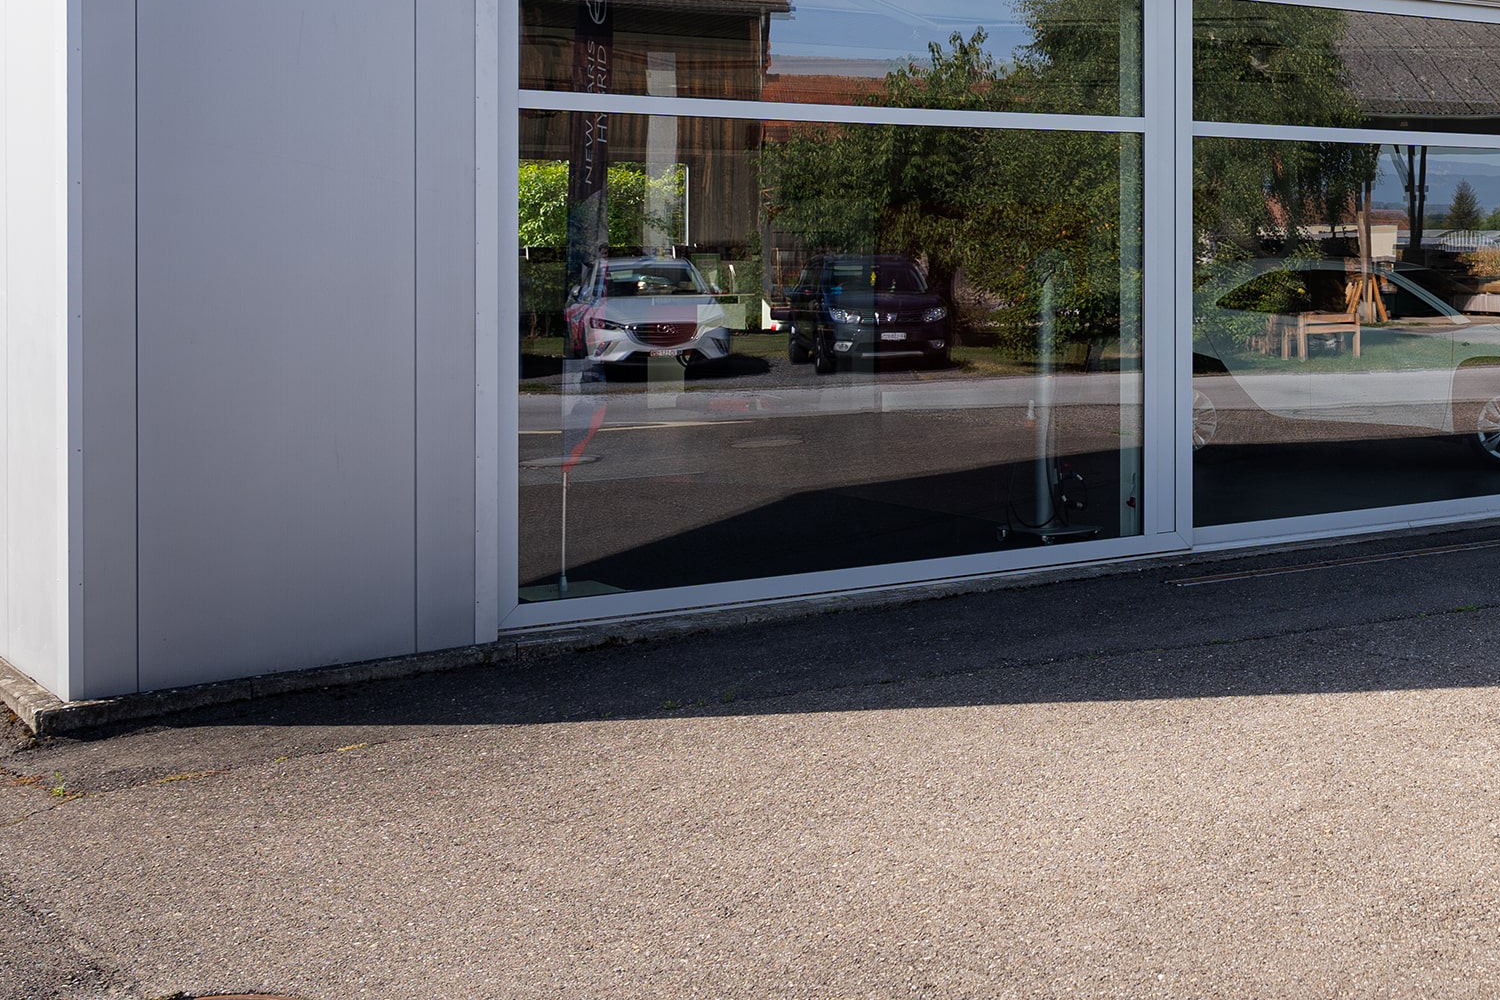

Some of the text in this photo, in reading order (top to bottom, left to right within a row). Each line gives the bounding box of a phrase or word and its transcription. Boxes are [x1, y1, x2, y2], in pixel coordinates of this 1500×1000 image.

[585, 40, 595, 184] NEW ARIS
[597, 44, 608, 143] HYRID
